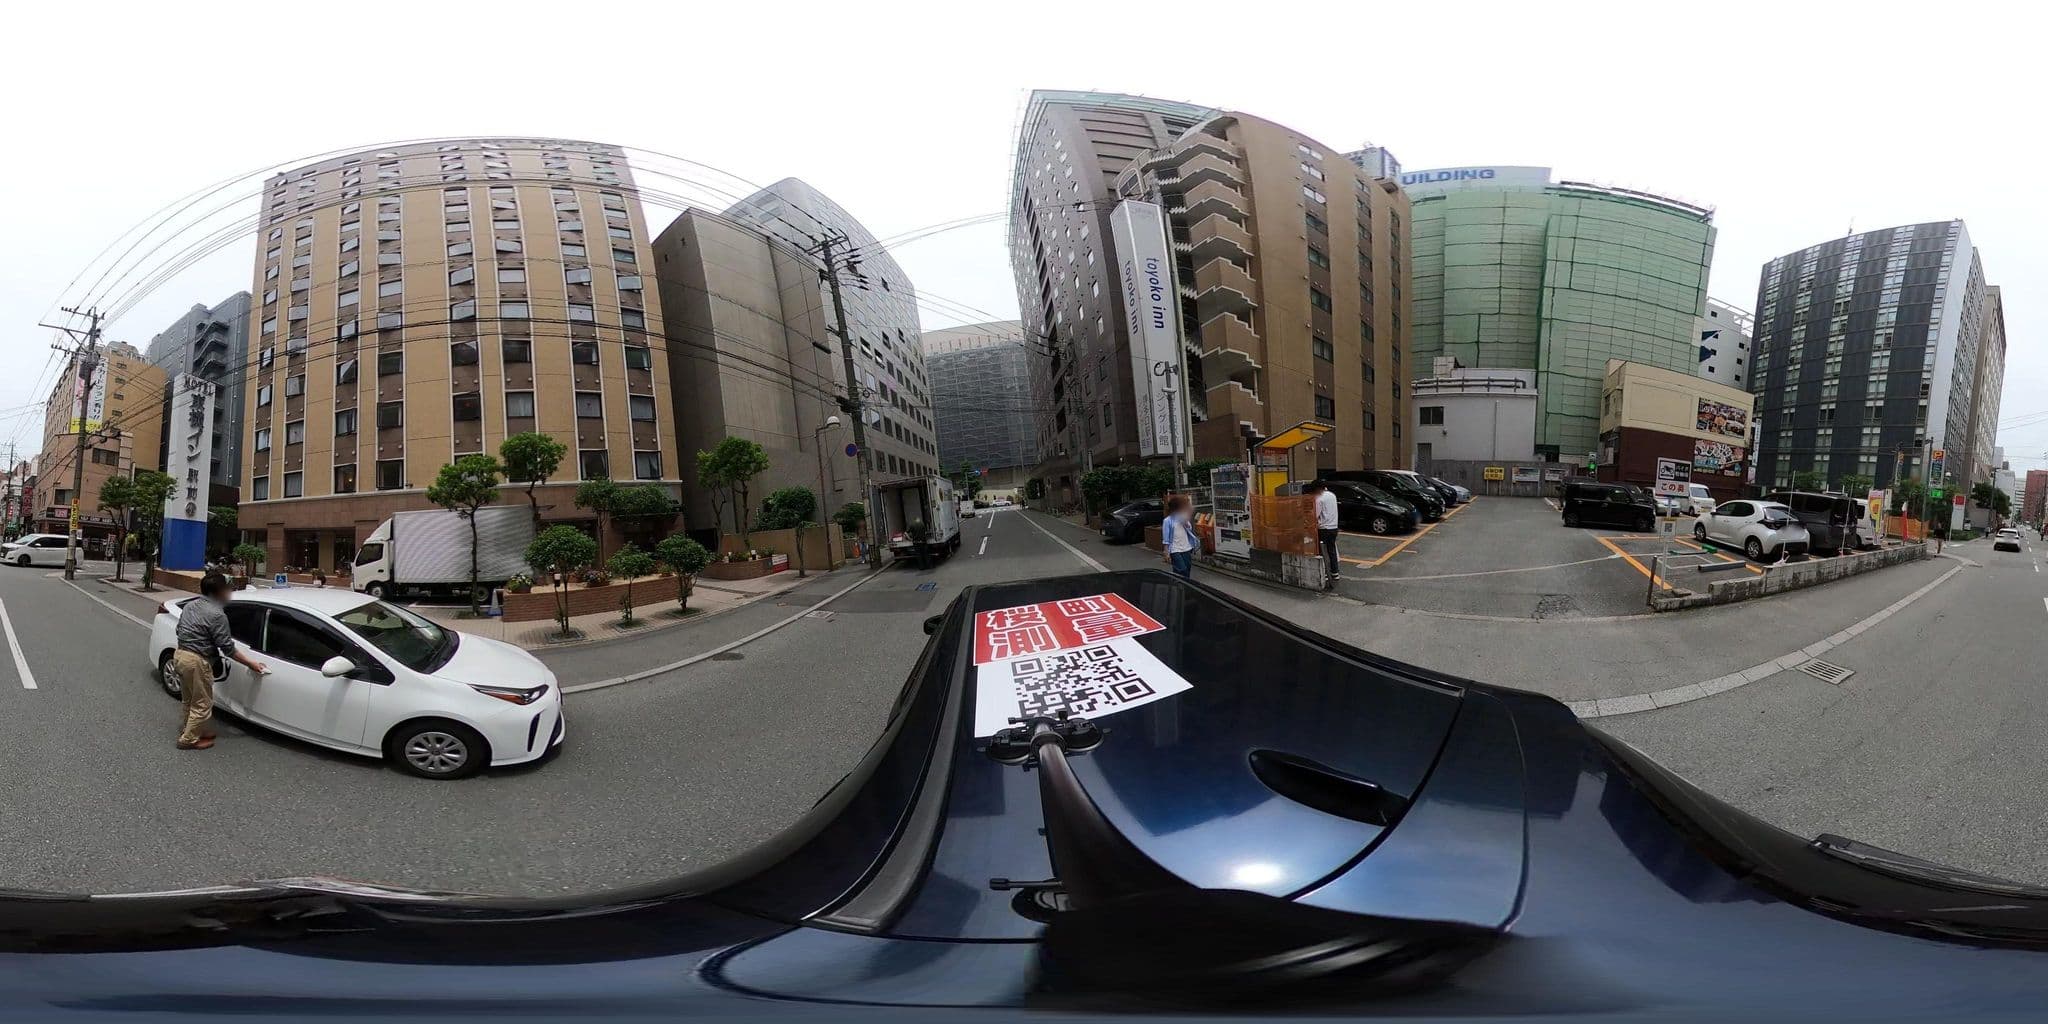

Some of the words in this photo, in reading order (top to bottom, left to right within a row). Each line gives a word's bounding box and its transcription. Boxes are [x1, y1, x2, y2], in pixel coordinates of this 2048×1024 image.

[1125, 260, 1136, 307] toyoko
[1131, 308, 1139, 335] inn
[1145, 257, 1164, 302] toyoko
[1152, 305, 1167, 329] inn
[183, 375, 214, 395] HOTEL
[187, 393, 206, 462] 東横イン
[989, 612, 1148, 661] 測量
